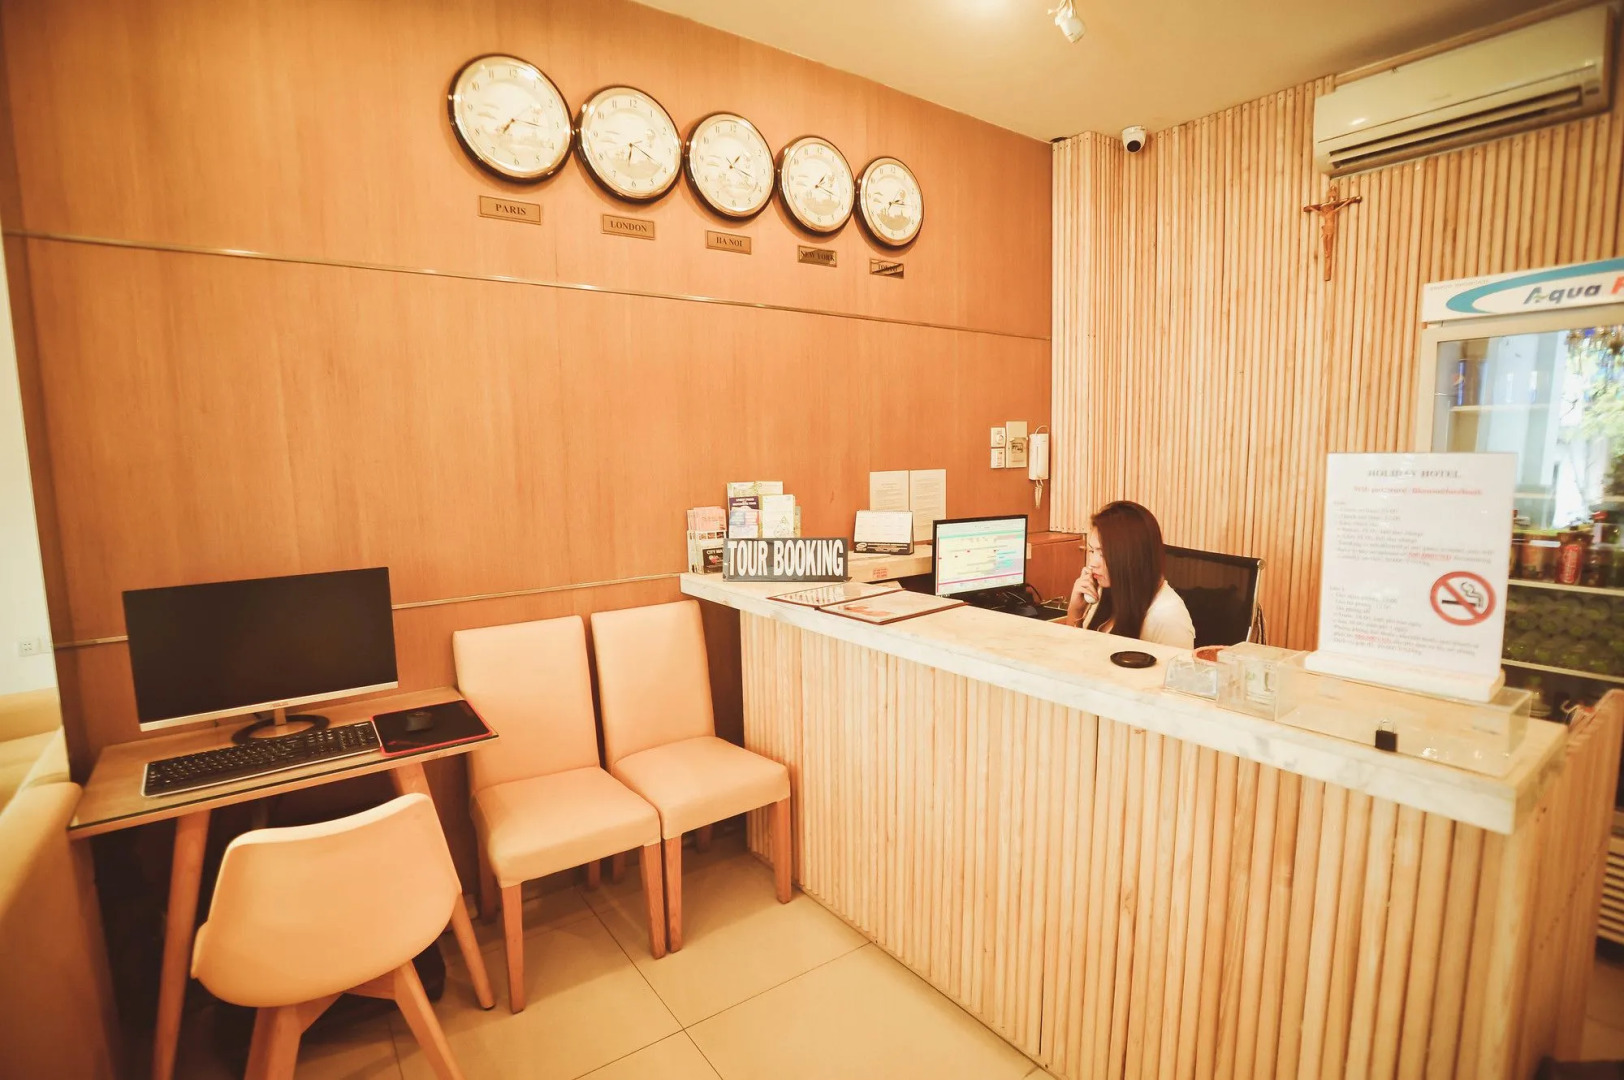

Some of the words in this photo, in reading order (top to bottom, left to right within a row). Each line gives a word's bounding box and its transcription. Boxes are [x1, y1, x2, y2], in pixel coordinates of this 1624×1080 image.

[495, 204, 526, 216] PARIS
[610, 220, 648, 232] LONDON
[716, 236, 727, 244] HA
[729, 239, 742, 247] NOI
[1523, 284, 1602, 304] Aqua
[728, 540, 768, 576] TOUR
[774, 540, 844, 576] BOOKING
